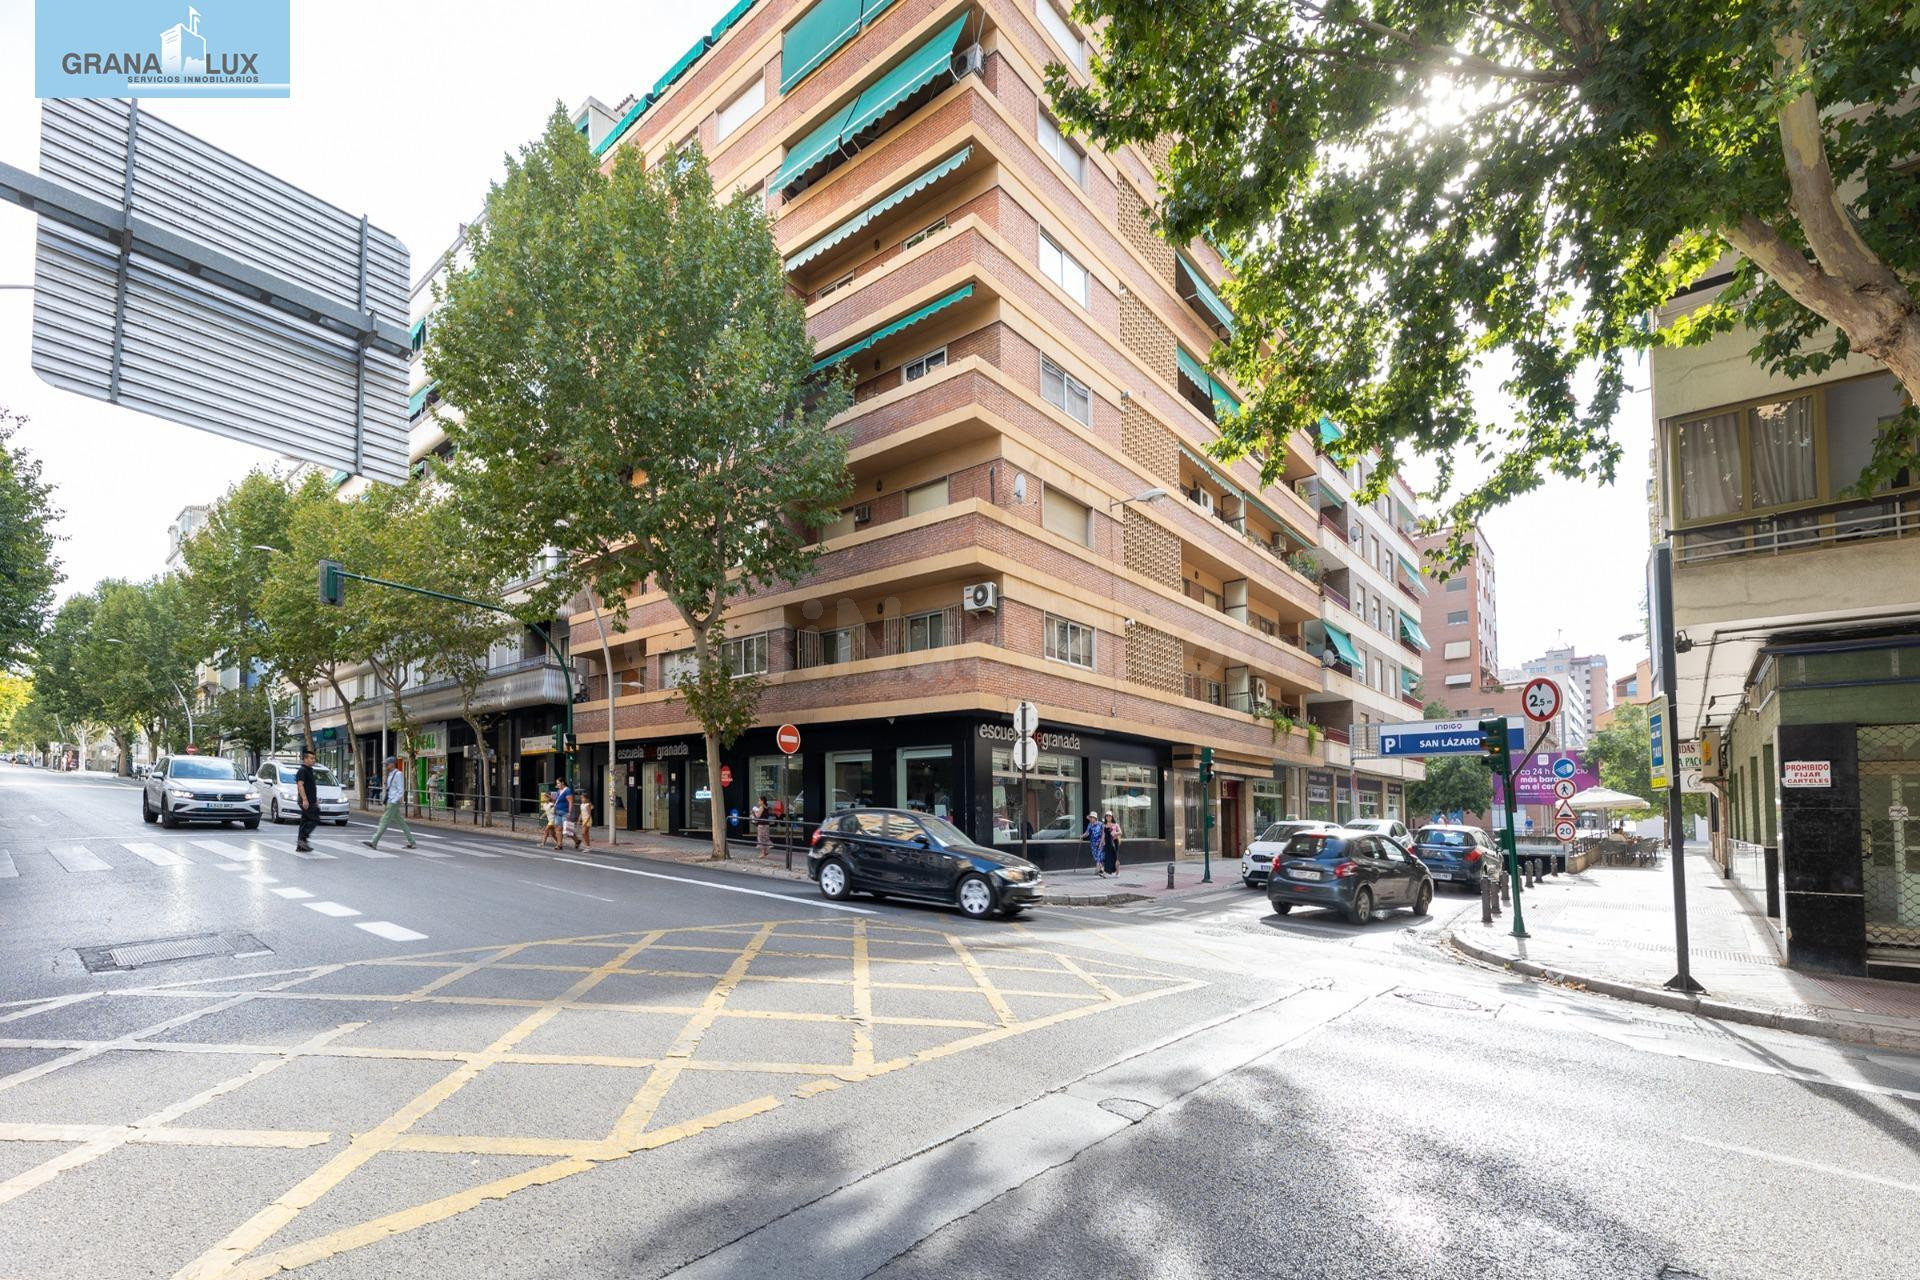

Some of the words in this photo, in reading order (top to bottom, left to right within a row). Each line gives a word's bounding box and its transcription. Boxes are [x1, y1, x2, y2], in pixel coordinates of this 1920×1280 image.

[1043, 732, 1080, 750] granada
[1385, 738, 1396, 753] P
[1419, 739, 1438, 749] SAN
[1441, 736, 1480, 748] LÁZARO
[656, 742, 689, 760] granada
[1786, 763, 1829, 771] PROHIBIDO
[1559, 827, 1571, 835] 20
